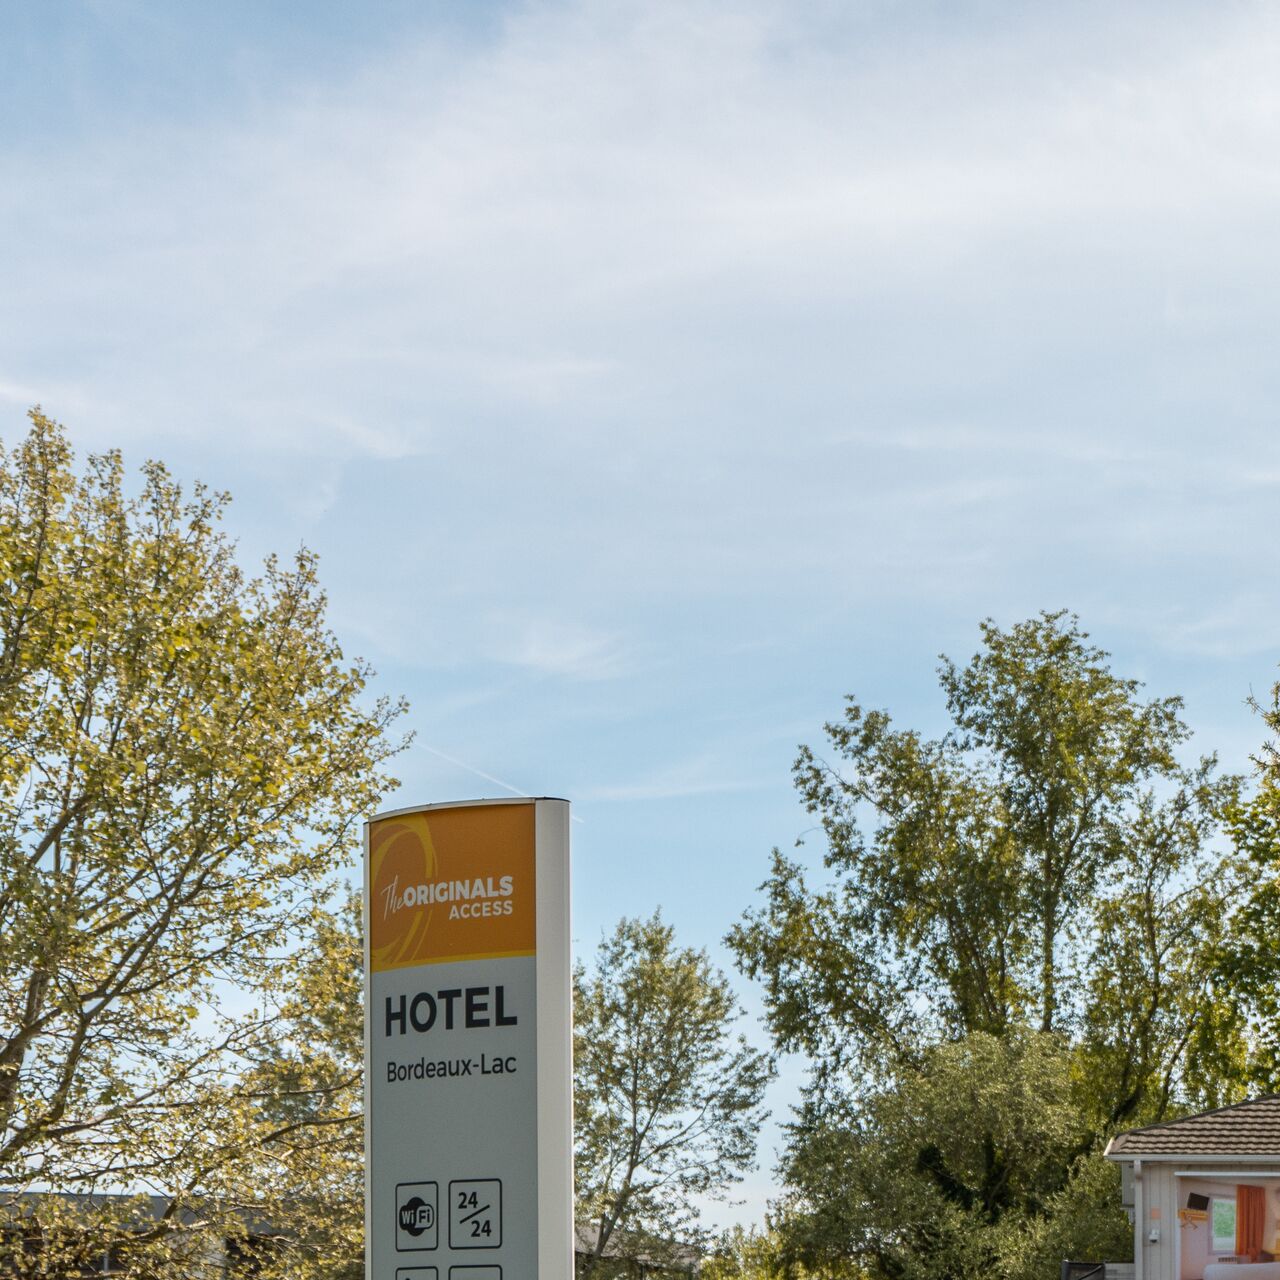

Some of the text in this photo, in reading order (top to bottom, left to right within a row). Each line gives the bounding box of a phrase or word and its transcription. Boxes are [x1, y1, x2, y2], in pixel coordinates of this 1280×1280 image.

[381, 874, 514, 921] The ORIGINALS
[449, 901, 513, 920] ACCESS
[385, 985, 518, 1037] HOTEL
[387, 1053, 517, 1083] Bordeaux-Lac
